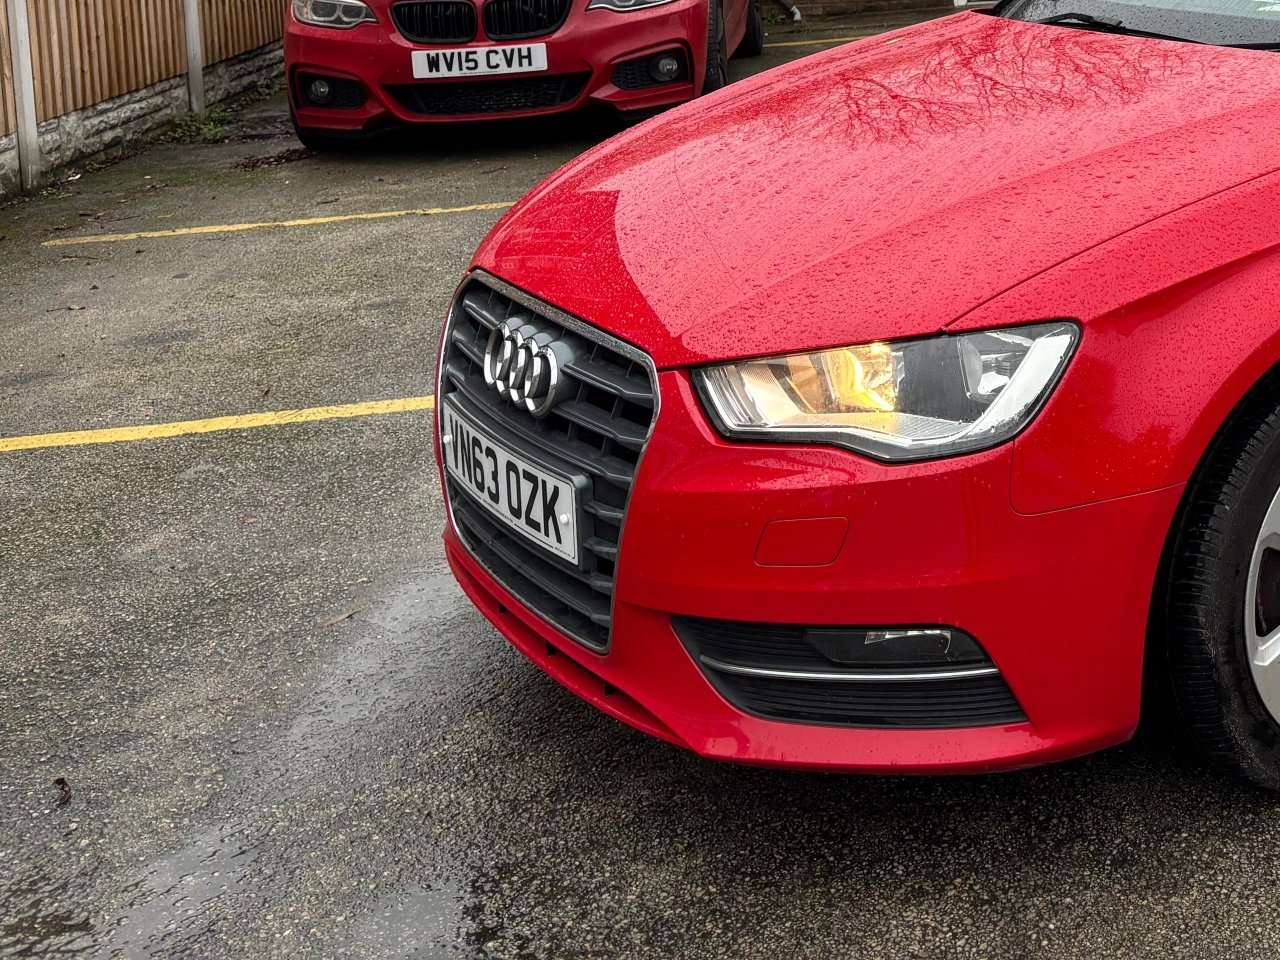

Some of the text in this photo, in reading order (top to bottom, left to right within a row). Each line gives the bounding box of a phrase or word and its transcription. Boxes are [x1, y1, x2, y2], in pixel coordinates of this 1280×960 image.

[426, 47, 533, 73] WV15 CVH
[449, 414, 562, 545] VN63 OZK
